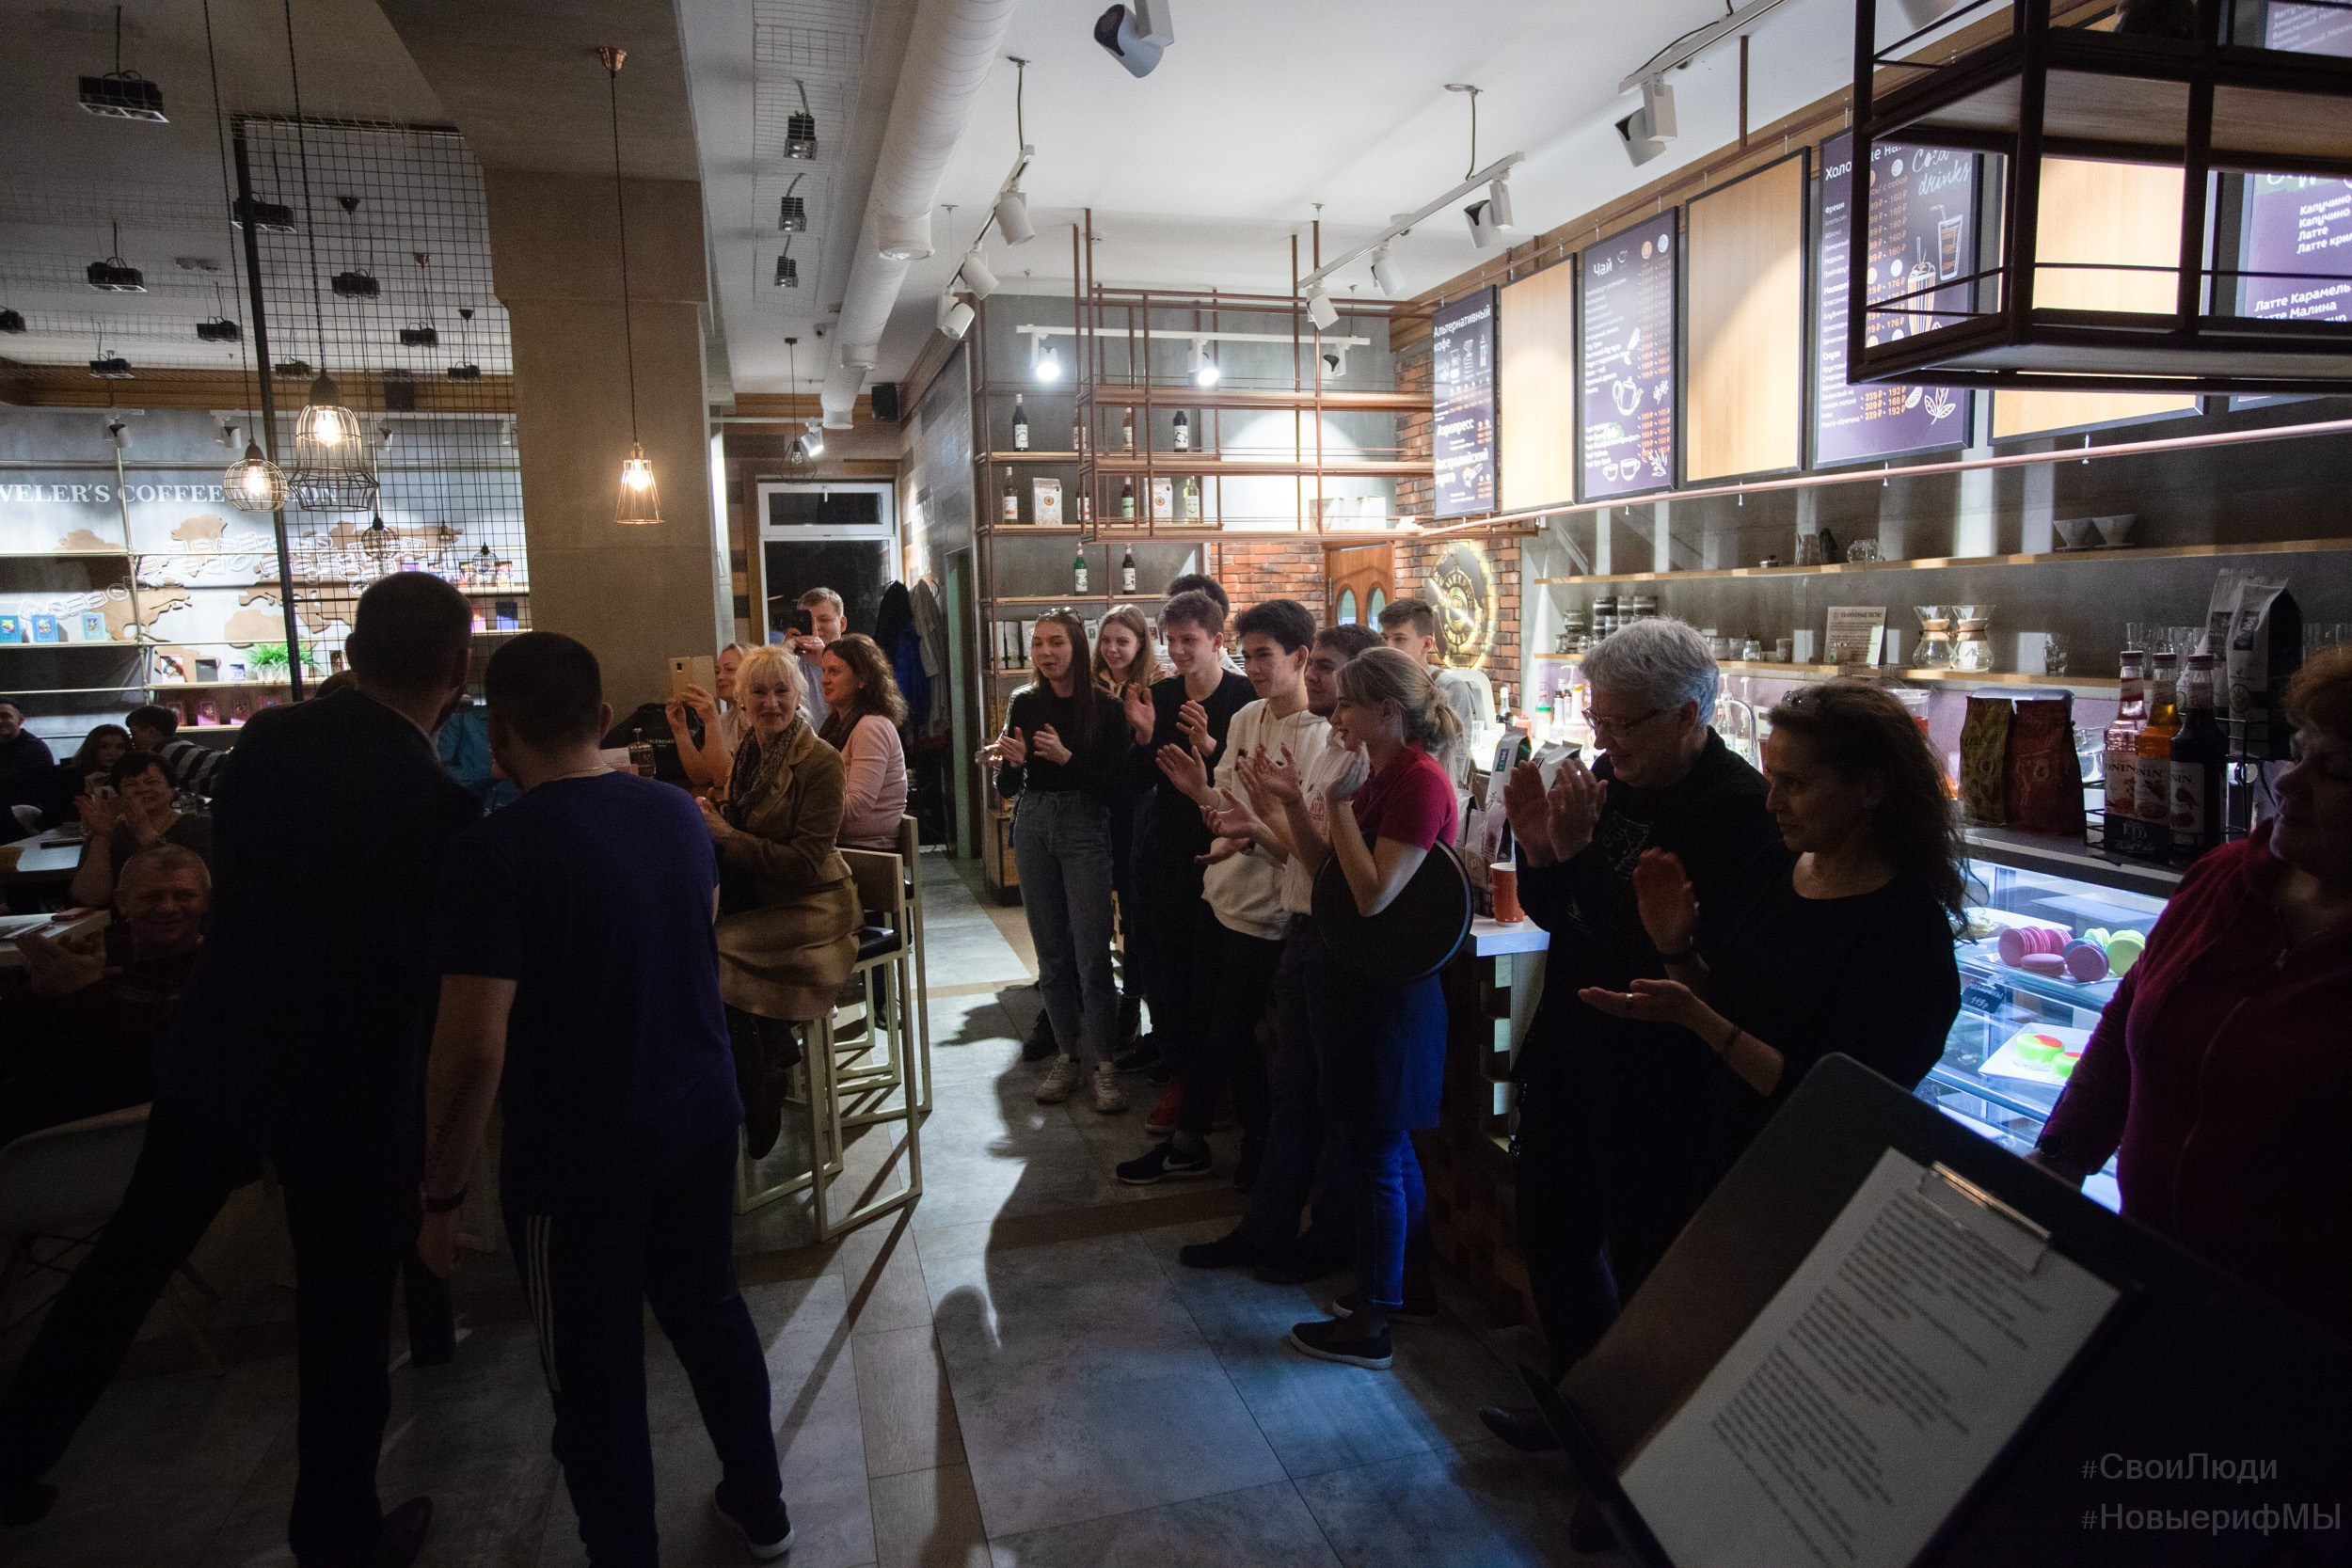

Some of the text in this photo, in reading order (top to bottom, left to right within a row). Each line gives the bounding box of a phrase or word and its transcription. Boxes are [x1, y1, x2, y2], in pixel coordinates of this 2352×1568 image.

[2300, 195, 2352, 216] Капучино
[2298, 208, 2351, 229] Капучино
[2297, 226, 2328, 242] Латте
[2296, 239, 2328, 254] Латте
[1593, 258, 1613, 277] Чай
[2254, 283, 2351, 312] Латте Карамель
[2290, 301, 2337, 318] Малина
[1434, 304, 1491, 339] Альтернативный
[1434, 338, 1451, 353] кофе
[0, 483, 110, 502] VELER'S
[118, 483, 225, 502] COFFEE
